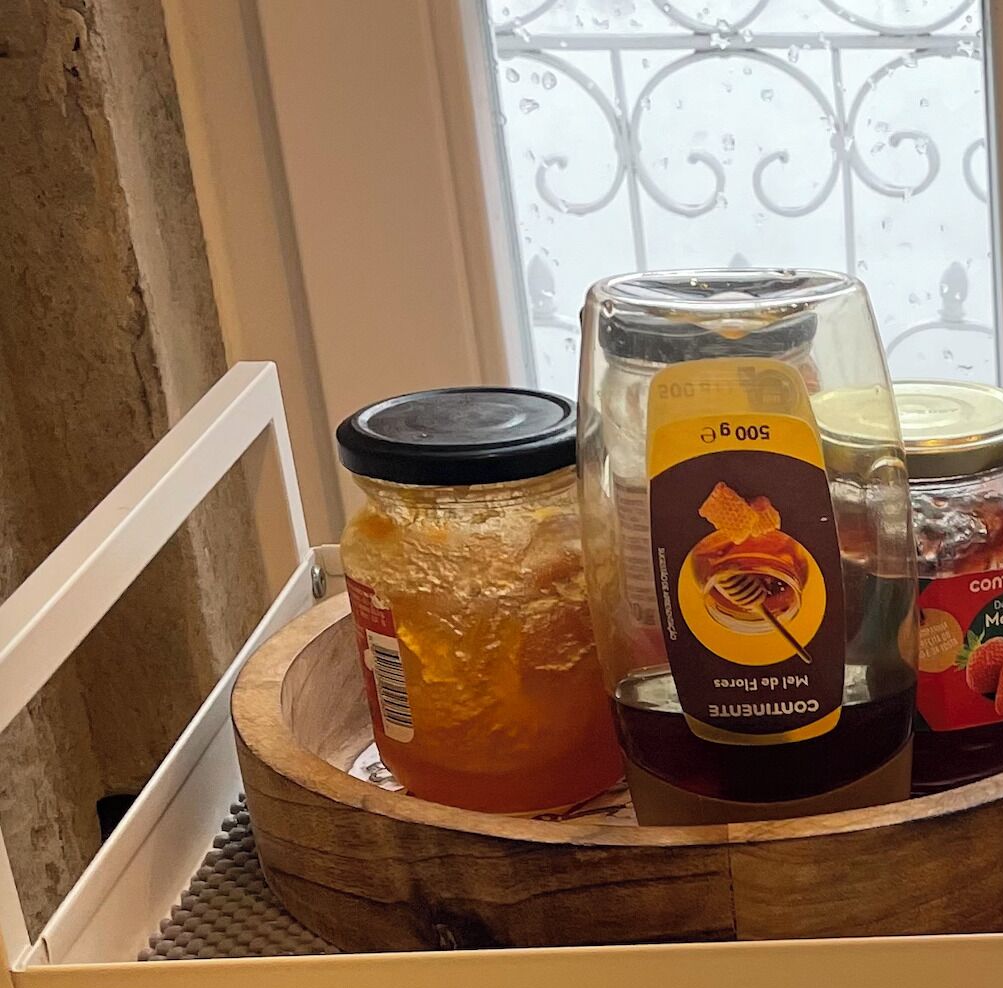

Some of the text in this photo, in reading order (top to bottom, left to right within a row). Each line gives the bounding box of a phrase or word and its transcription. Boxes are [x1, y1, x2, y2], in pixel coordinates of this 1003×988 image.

[720, 422, 731, 438] g
[736, 425, 770, 441] 500
[713, 675, 809, 691] Mel de Flores
[708, 699, 820, 717] CONTINENTE
